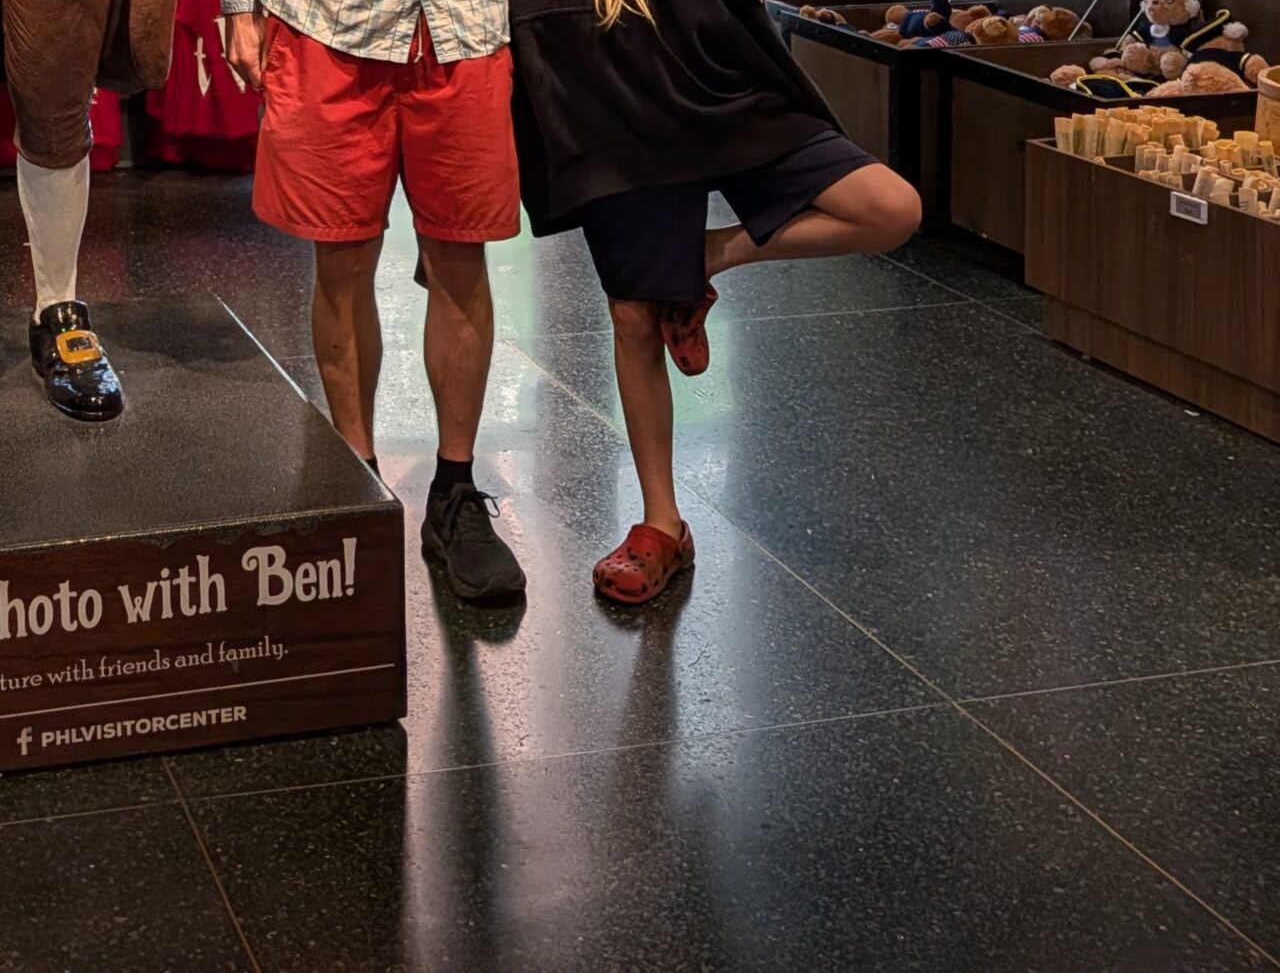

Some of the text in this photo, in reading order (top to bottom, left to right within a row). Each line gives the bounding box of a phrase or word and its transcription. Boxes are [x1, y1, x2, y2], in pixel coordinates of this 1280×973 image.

[118, 554, 227, 623] with
[241, 537, 358, 607] Ben!
[47, 659, 96, 685] with
[98, 649, 171, 678] friends
[174, 642, 214, 669] and
[218, 635, 290, 665] family.
[40, 705, 248, 748] PHLVISITORCENTER
